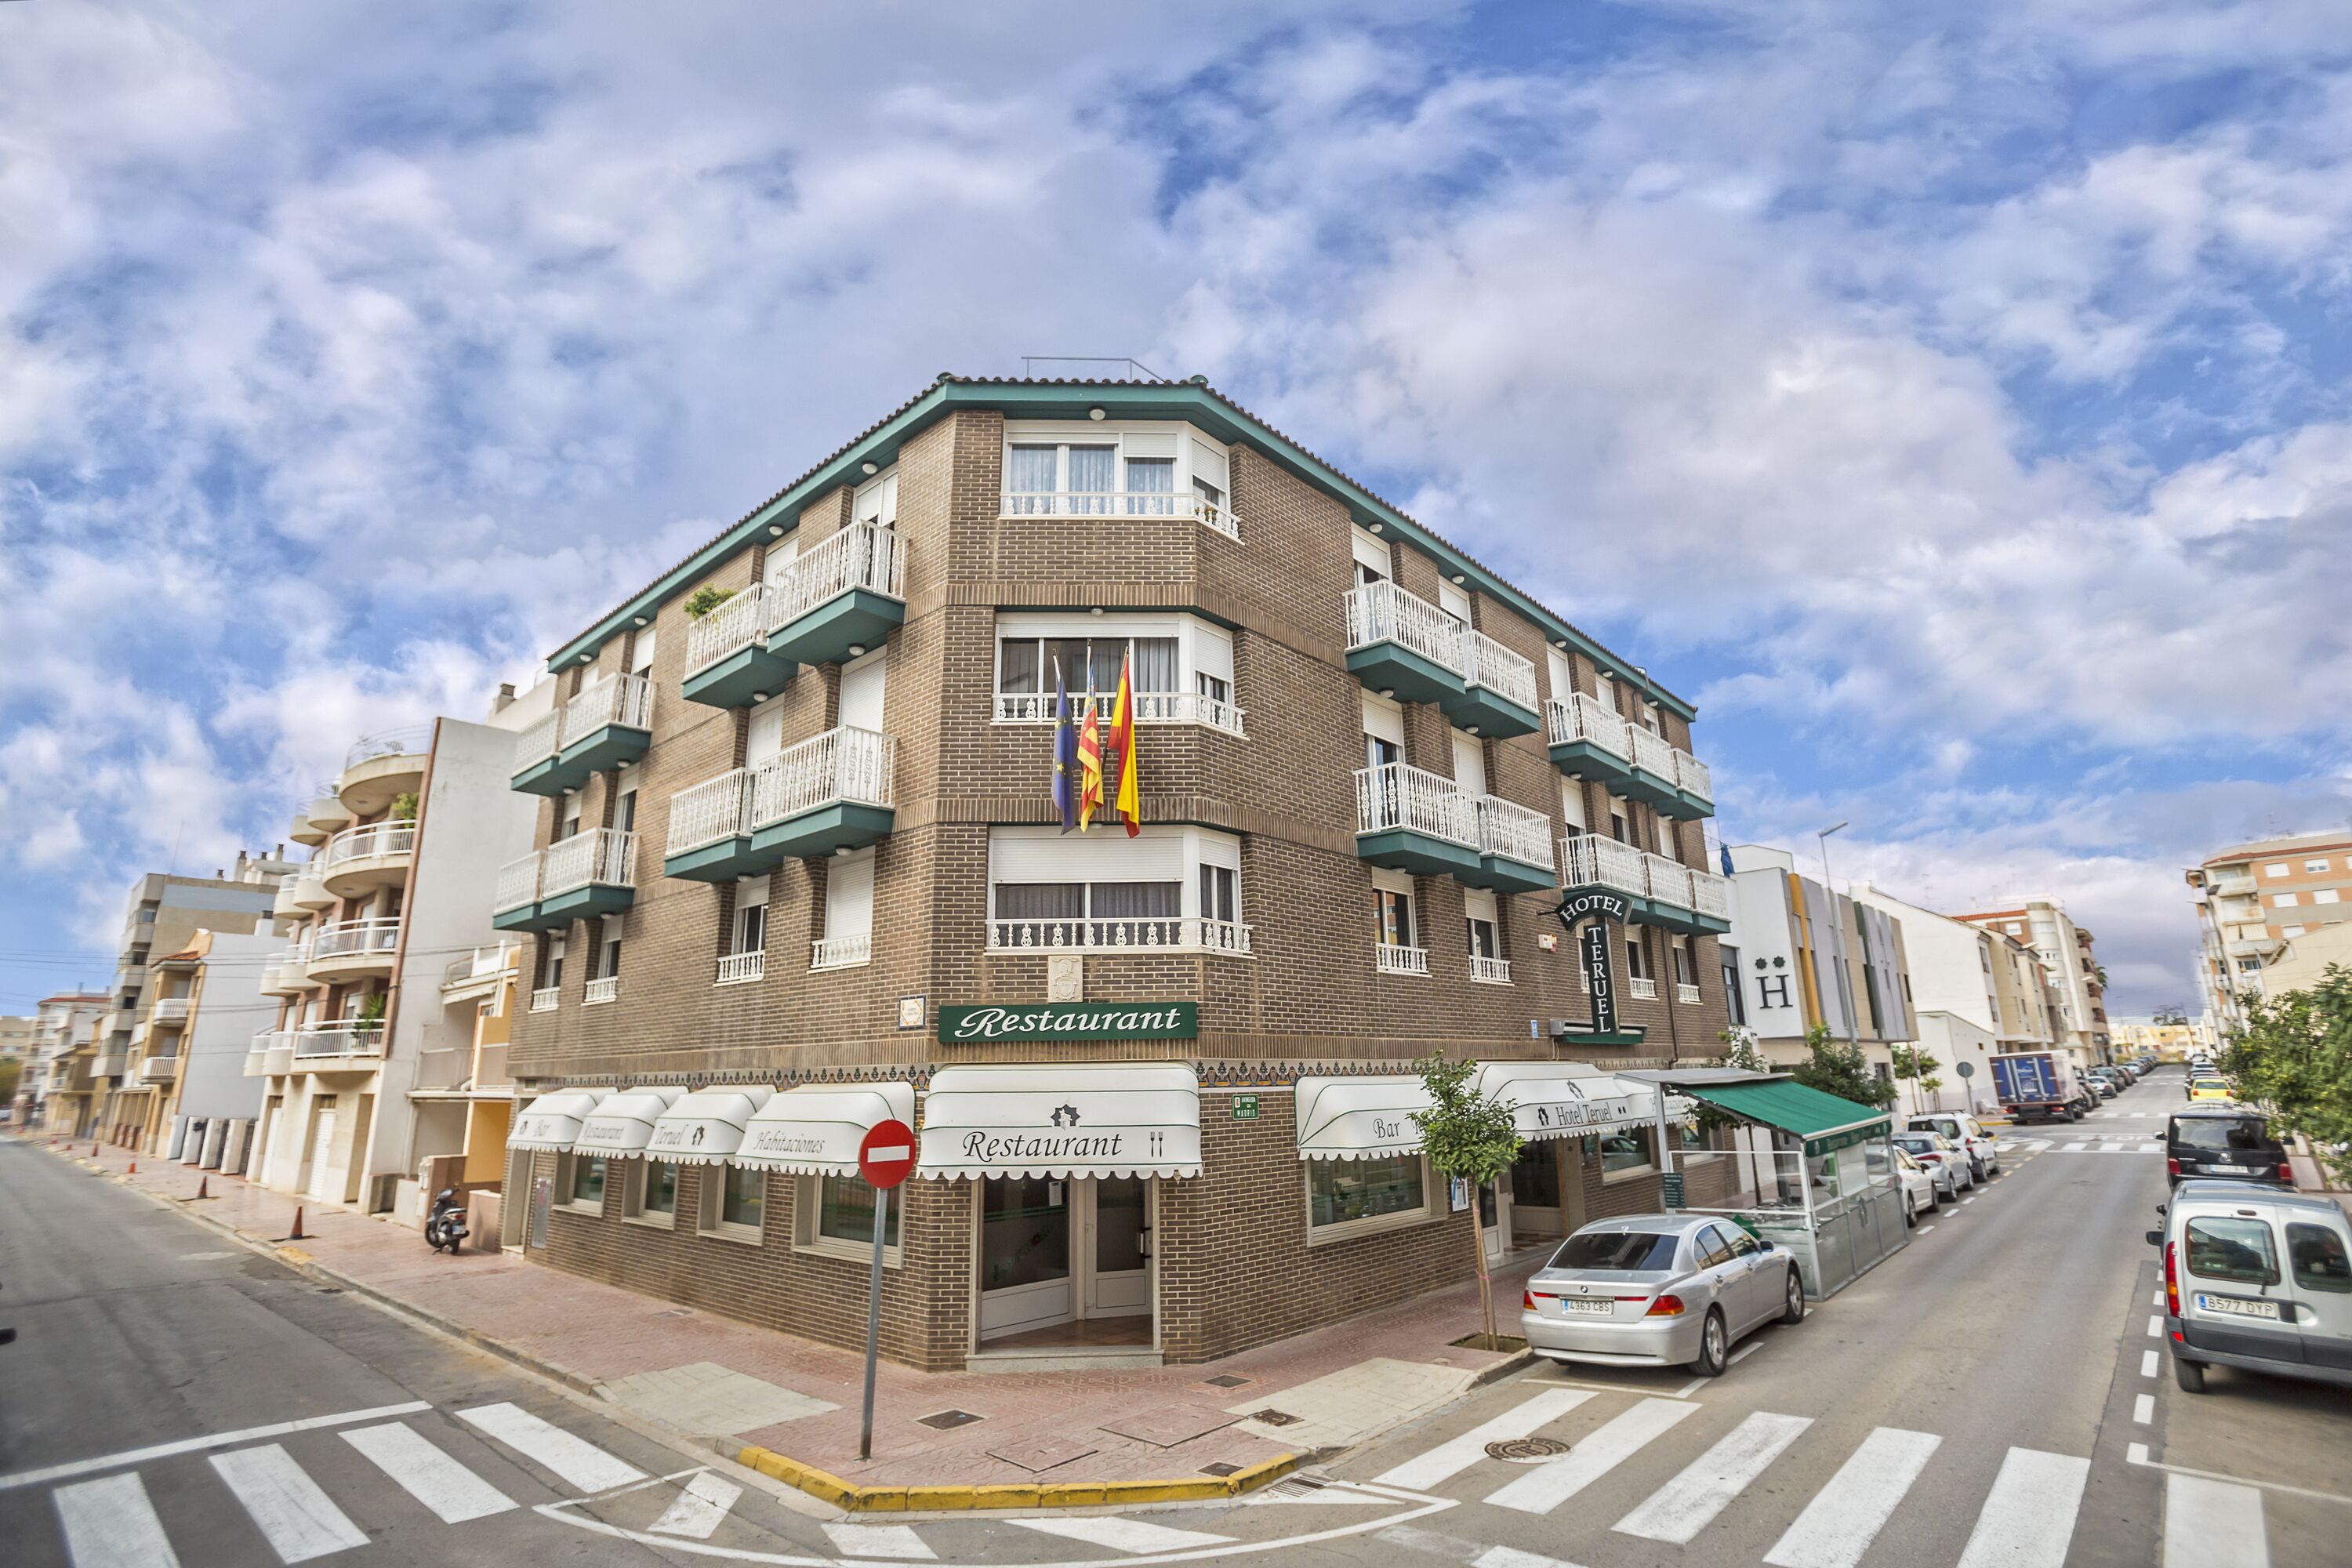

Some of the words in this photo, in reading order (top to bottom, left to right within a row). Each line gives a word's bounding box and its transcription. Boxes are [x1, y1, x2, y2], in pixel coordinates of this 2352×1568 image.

[1559, 895, 1623, 922] HOTEL
[1588, 927, 1611, 1033] TERUEL
[953, 1008, 1181, 1038] Restaurant
[1555, 1104, 1584, 1126] Hotel
[1582, 1102, 1613, 1123] Teruel
[654, 1123, 689, 1145] Teruel
[1373, 1117, 1400, 1138] Bar
[753, 1130, 826, 1154] Habitaciones
[963, 1131, 1123, 1163] Restaurant
[1570, 1301, 1591, 1311] 4363
[1593, 1301, 1610, 1312] CBS
[2208, 1298, 2241, 1312] 8577
[2246, 1302, 2272, 1316] DYP
